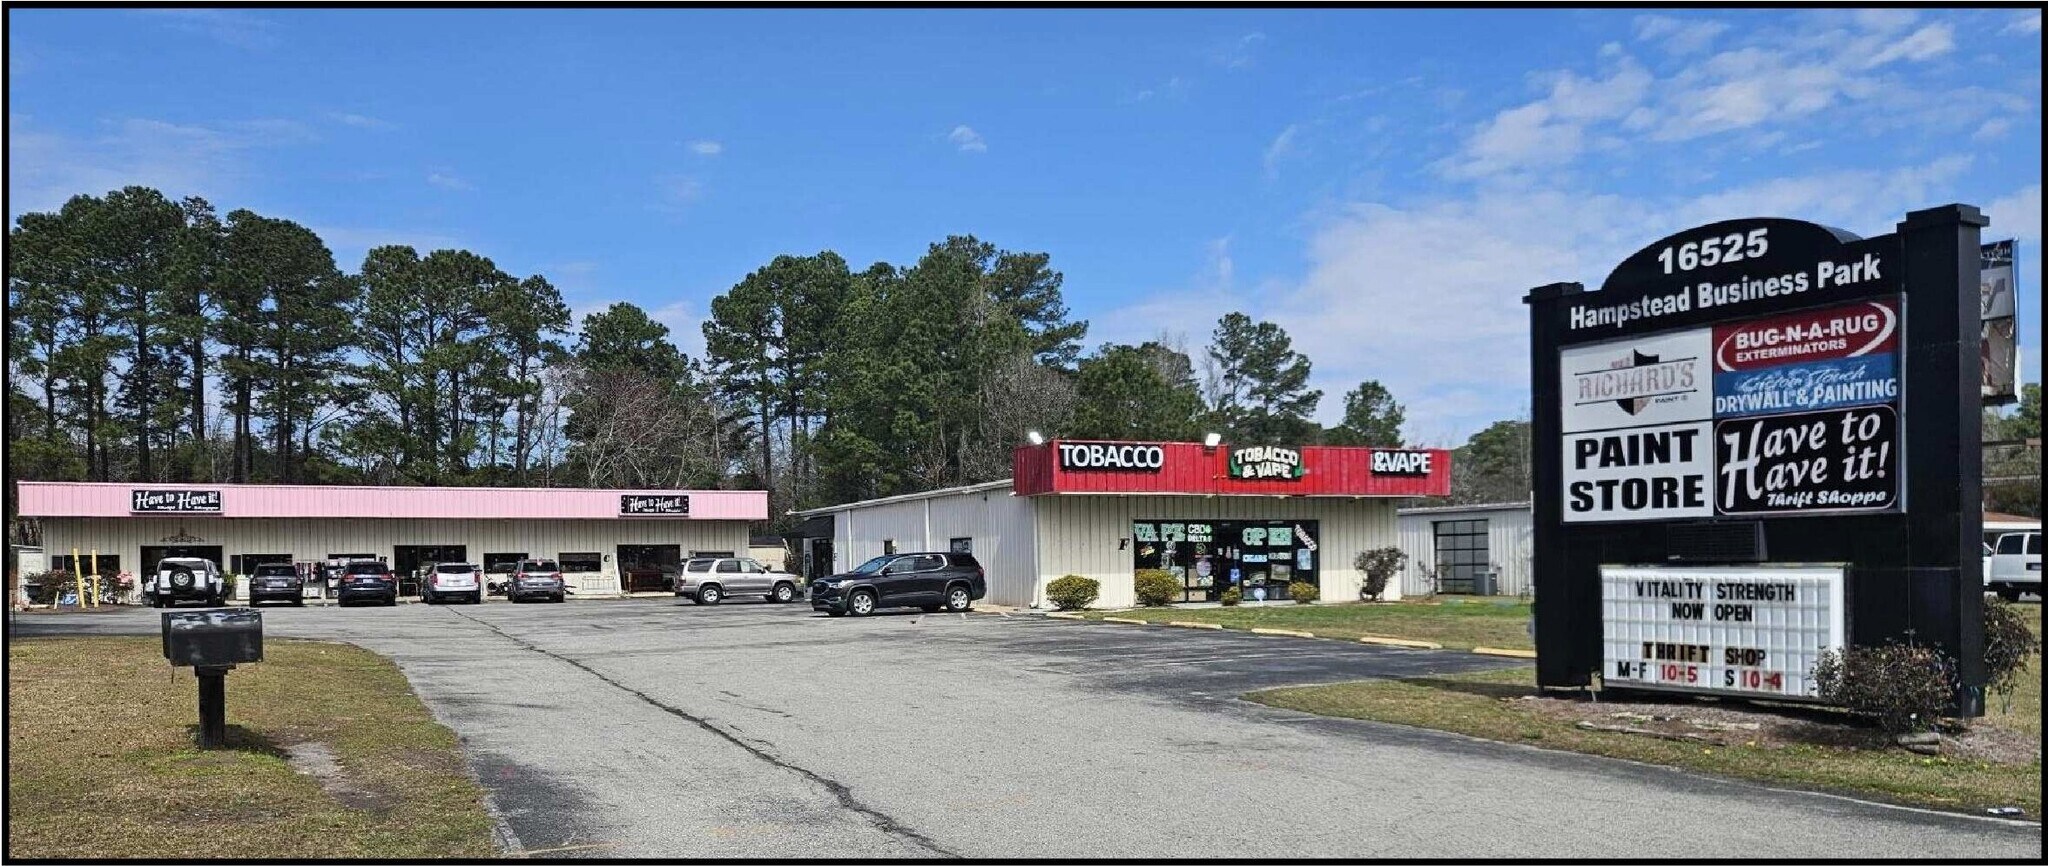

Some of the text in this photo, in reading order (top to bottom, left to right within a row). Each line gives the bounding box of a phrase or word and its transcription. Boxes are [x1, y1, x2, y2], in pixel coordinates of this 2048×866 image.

[1658, 228, 1768, 274] 16525
[1570, 252, 1881, 330] Hampstead Business Park
[1735, 314, 1878, 349] BUG-N-A-RUG
[1736, 338, 1847, 362] EXTERMINATORS
[1579, 362, 1695, 399] RICHARD'S
[1716, 378, 1897, 414] DRYWALL & PAINTING
[1841, 411, 1881, 445] to
[1059, 445, 1164, 468] TOBACCO
[1234, 446, 1298, 466] TOBACCO
[1575, 429, 1699, 470] PAINT
[1243, 462, 1292, 478] & VAPE
[1373, 451, 1432, 474] &VAPE
[1842, 441, 1889, 483] it!
[136, 491, 163, 509] Have
[165, 492, 175, 504] to
[178, 491, 207, 509] Have
[1570, 474, 1704, 512] STORE
[1767, 490, 1887, 508] Thrift Shoppe
[1188, 524, 1205, 534] CBD
[1242, 527, 1292, 546] OPEN
[1118, 538, 1130, 550] F
[1636, 582, 1795, 601] VITALITY STRENGTH
[1672, 603, 1752, 621] NOW OPEN
[1643, 642, 1766, 666] THRIFT SHOP
[1617, 661, 1782, 689] M-F 10-5 S 10-4
